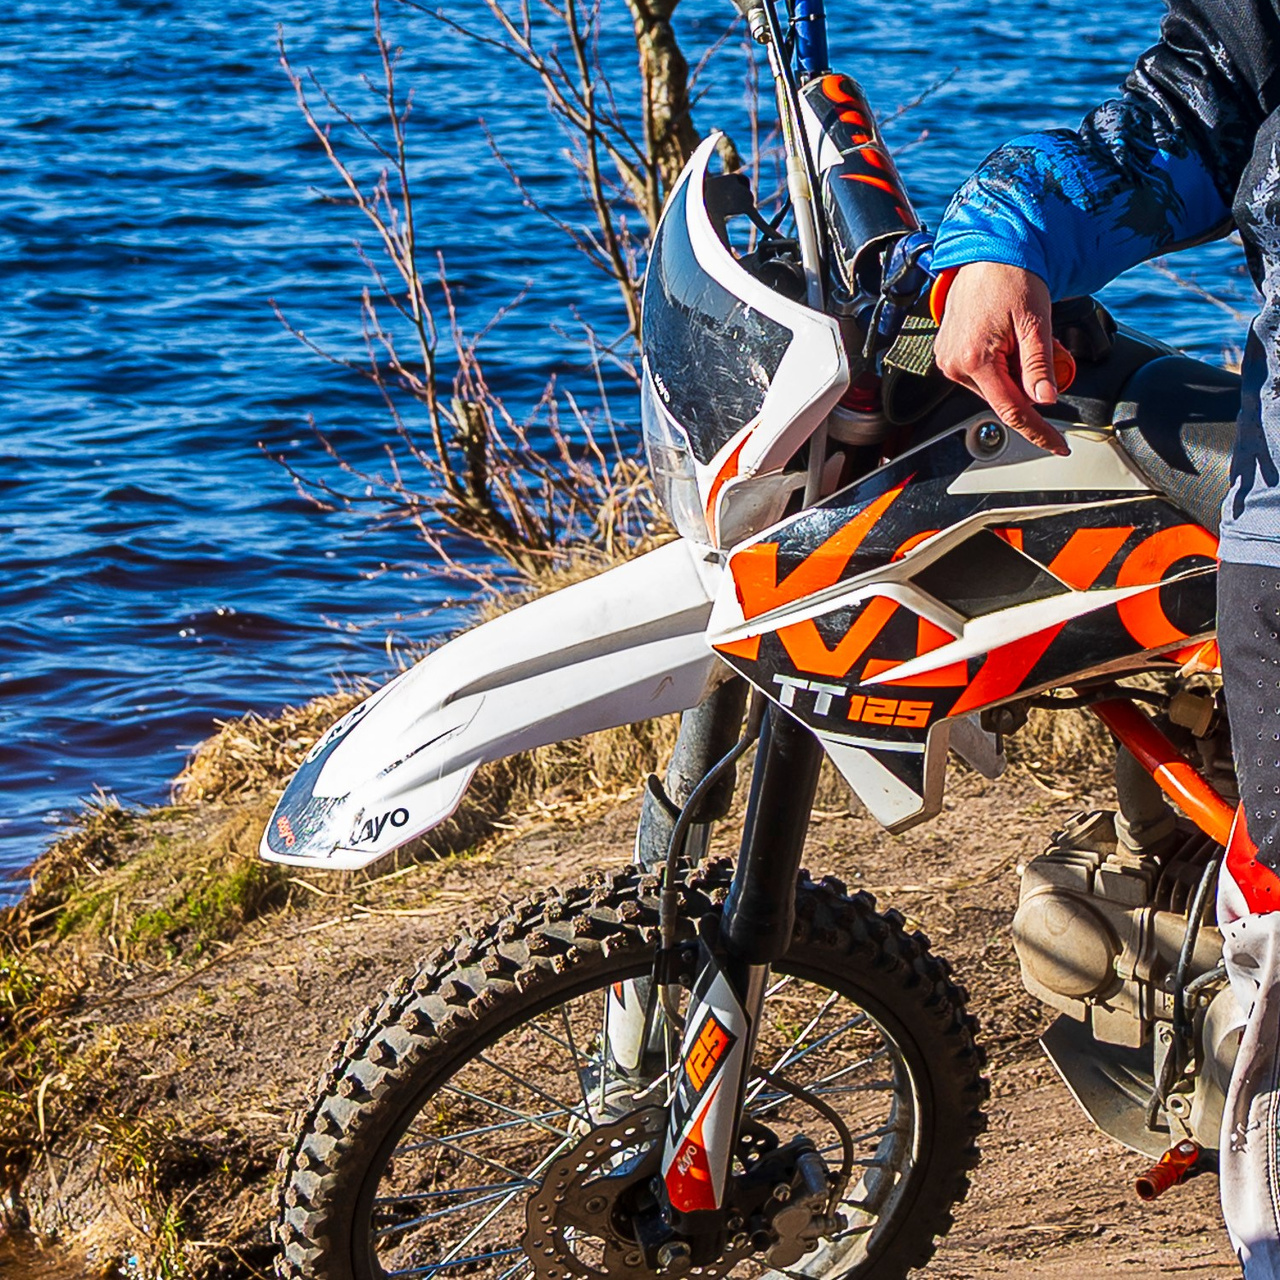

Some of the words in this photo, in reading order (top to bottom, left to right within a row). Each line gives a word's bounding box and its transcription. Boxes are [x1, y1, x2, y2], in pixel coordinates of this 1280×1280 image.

[772, 673, 848, 717] TT
[846, 694, 934, 729] 125
[684, 1017, 731, 1093] 125
